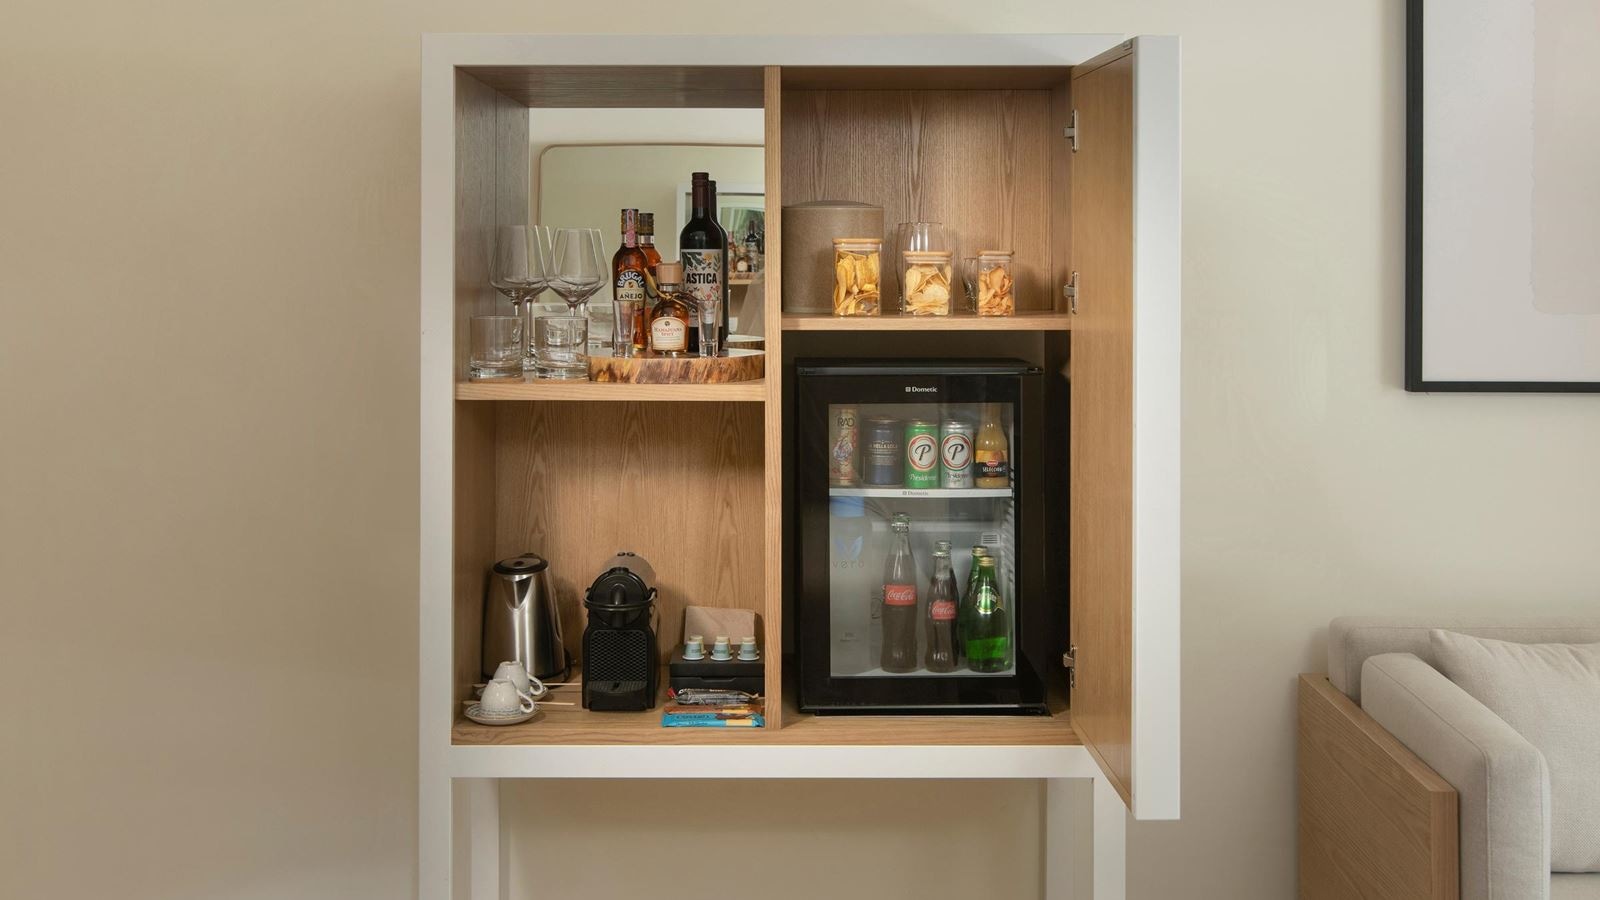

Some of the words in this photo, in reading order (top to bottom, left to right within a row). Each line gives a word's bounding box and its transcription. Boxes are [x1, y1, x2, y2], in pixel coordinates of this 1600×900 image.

[617, 271, 645, 288] BRUGAL
[686, 272, 718, 284] ASTICA
[619, 291, 643, 299] AÑEJO
[915, 444, 932, 461] P
[948, 443, 965, 461] P
